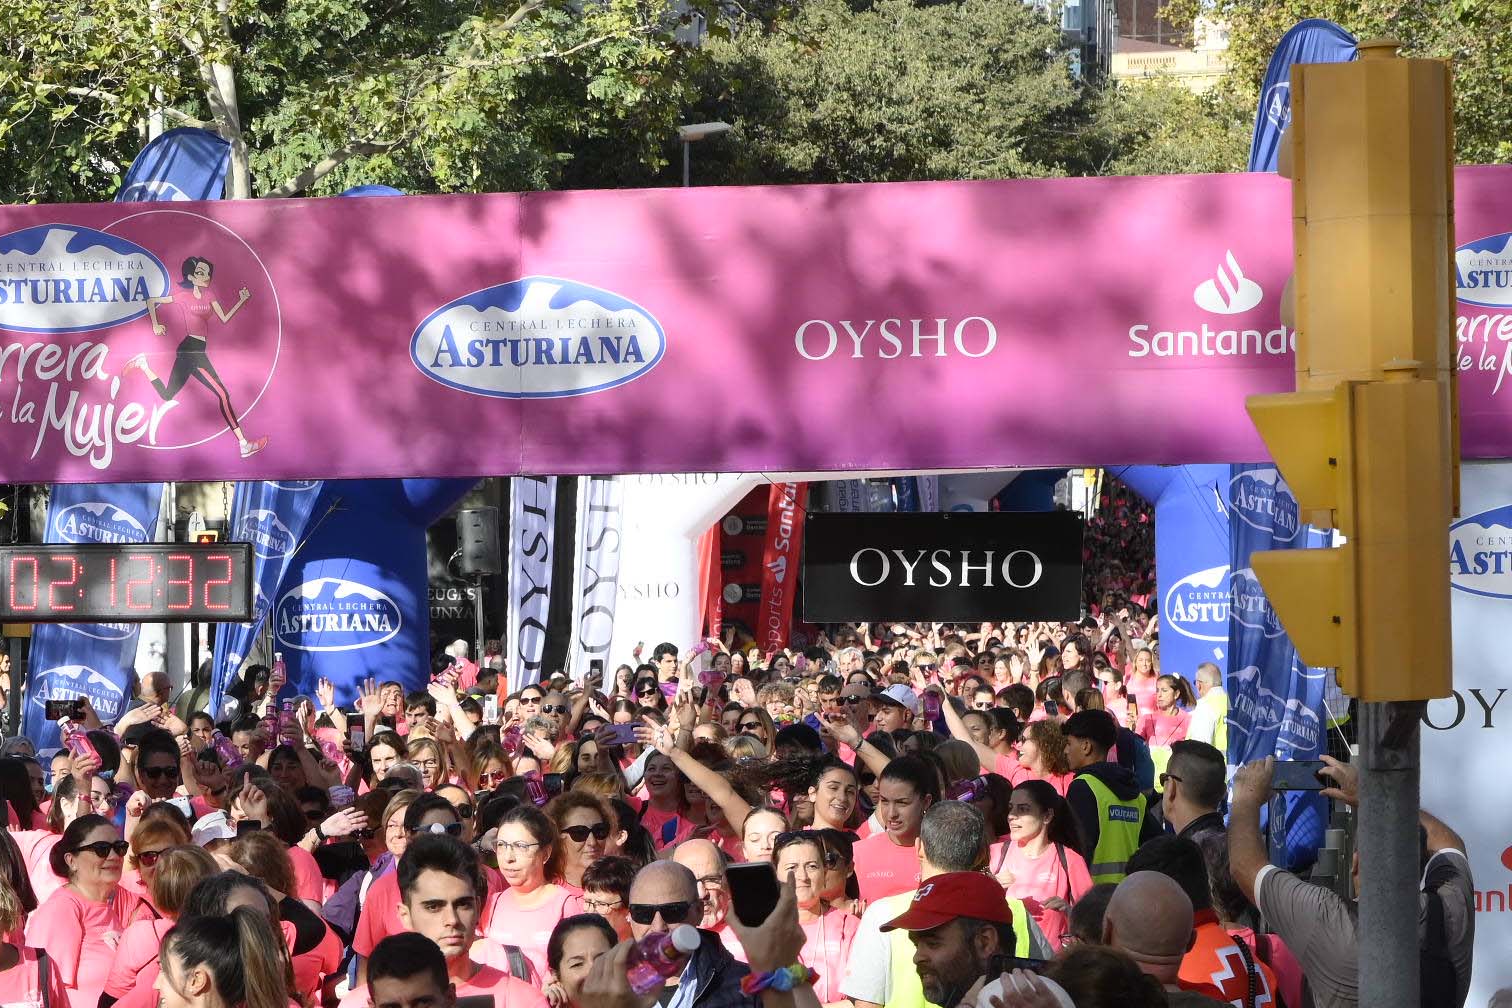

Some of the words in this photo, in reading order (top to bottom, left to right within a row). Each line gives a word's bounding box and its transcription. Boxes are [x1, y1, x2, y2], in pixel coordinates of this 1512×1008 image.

[73, 260, 144, 272] LECHERA
[470, 319, 548, 332] CENTRAL
[556, 317, 637, 330] LECHERA
[795, 316, 997, 360] OYSHO
[1456, 312, 1512, 343] arre
[431, 323, 645, 369] ASTURIANA
[1478, 347, 1496, 371] la
[11, 386, 35, 423] la
[30, 376, 180, 469] Mujer
[10, 556, 232, 610] 02:12:32
[849, 549, 1043, 588] OYSHO
[339, 602, 387, 611] LECHERA
[619, 582, 680, 600] YSHO
[279, 613, 393, 636] ASTURIANA
[36, 679, 119, 714] ASTUANA
